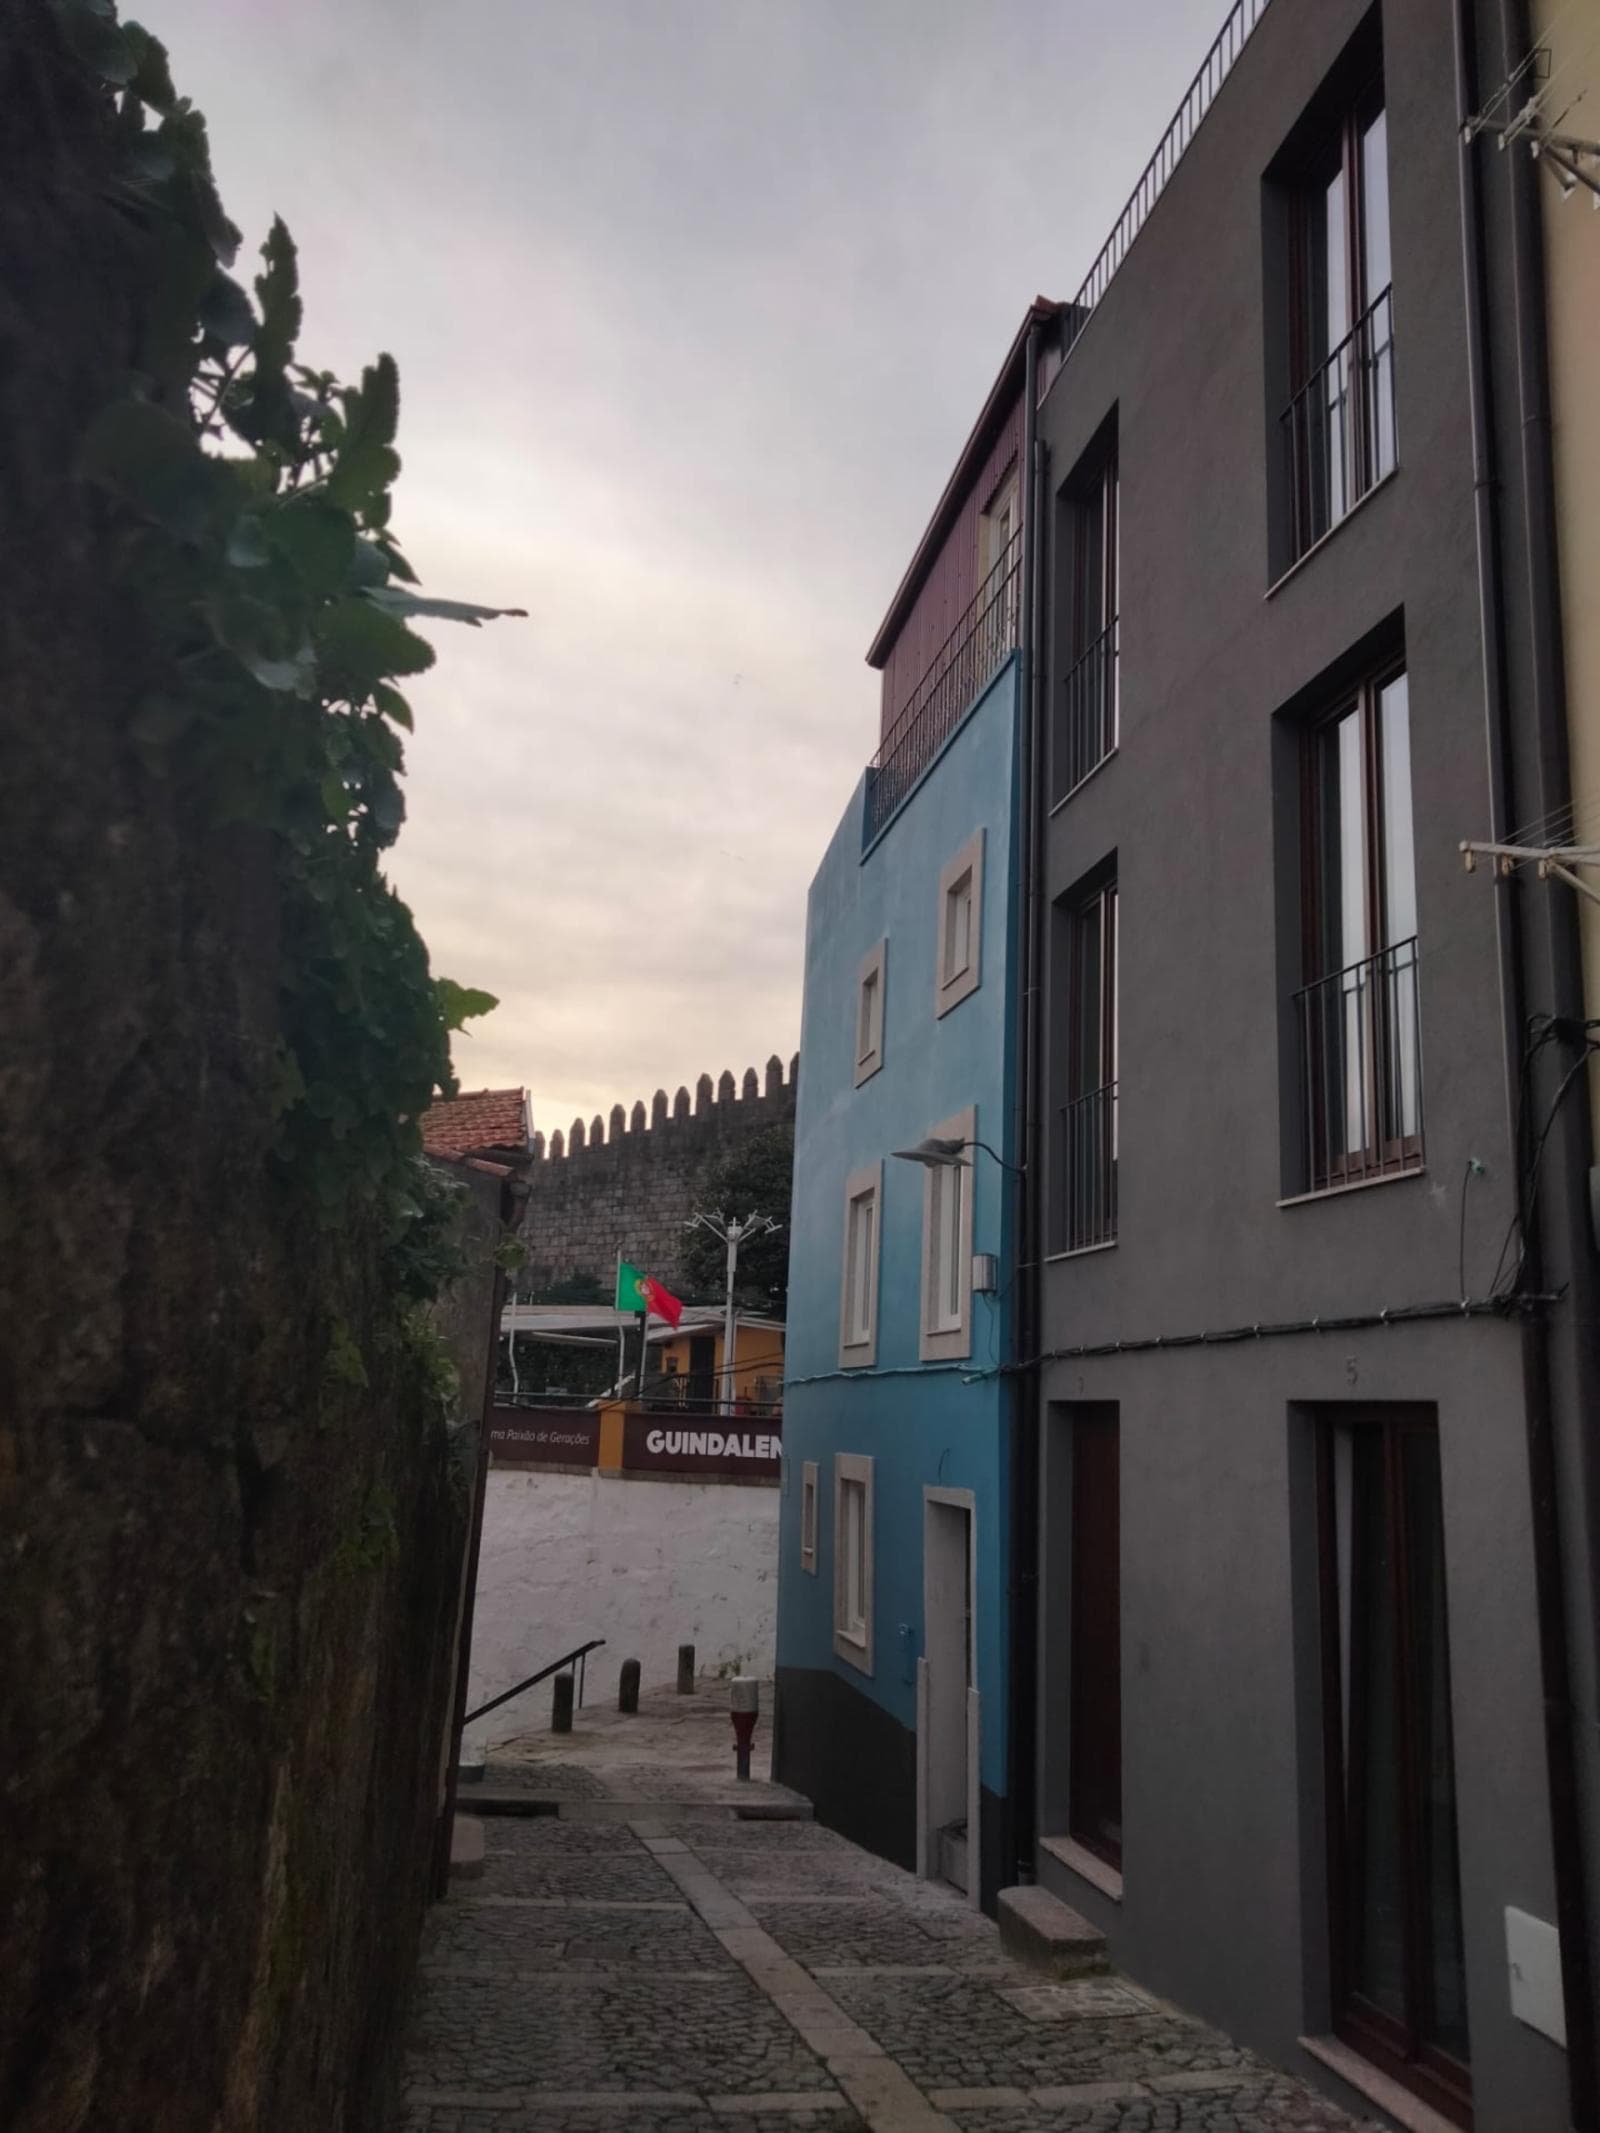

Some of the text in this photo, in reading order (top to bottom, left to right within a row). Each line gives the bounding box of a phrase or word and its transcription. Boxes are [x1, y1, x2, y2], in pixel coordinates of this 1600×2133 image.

[507, 1428, 536, 1442] Paixão
[536, 1430, 549, 1443] de
[549, 1431, 591, 1446] Gerações
